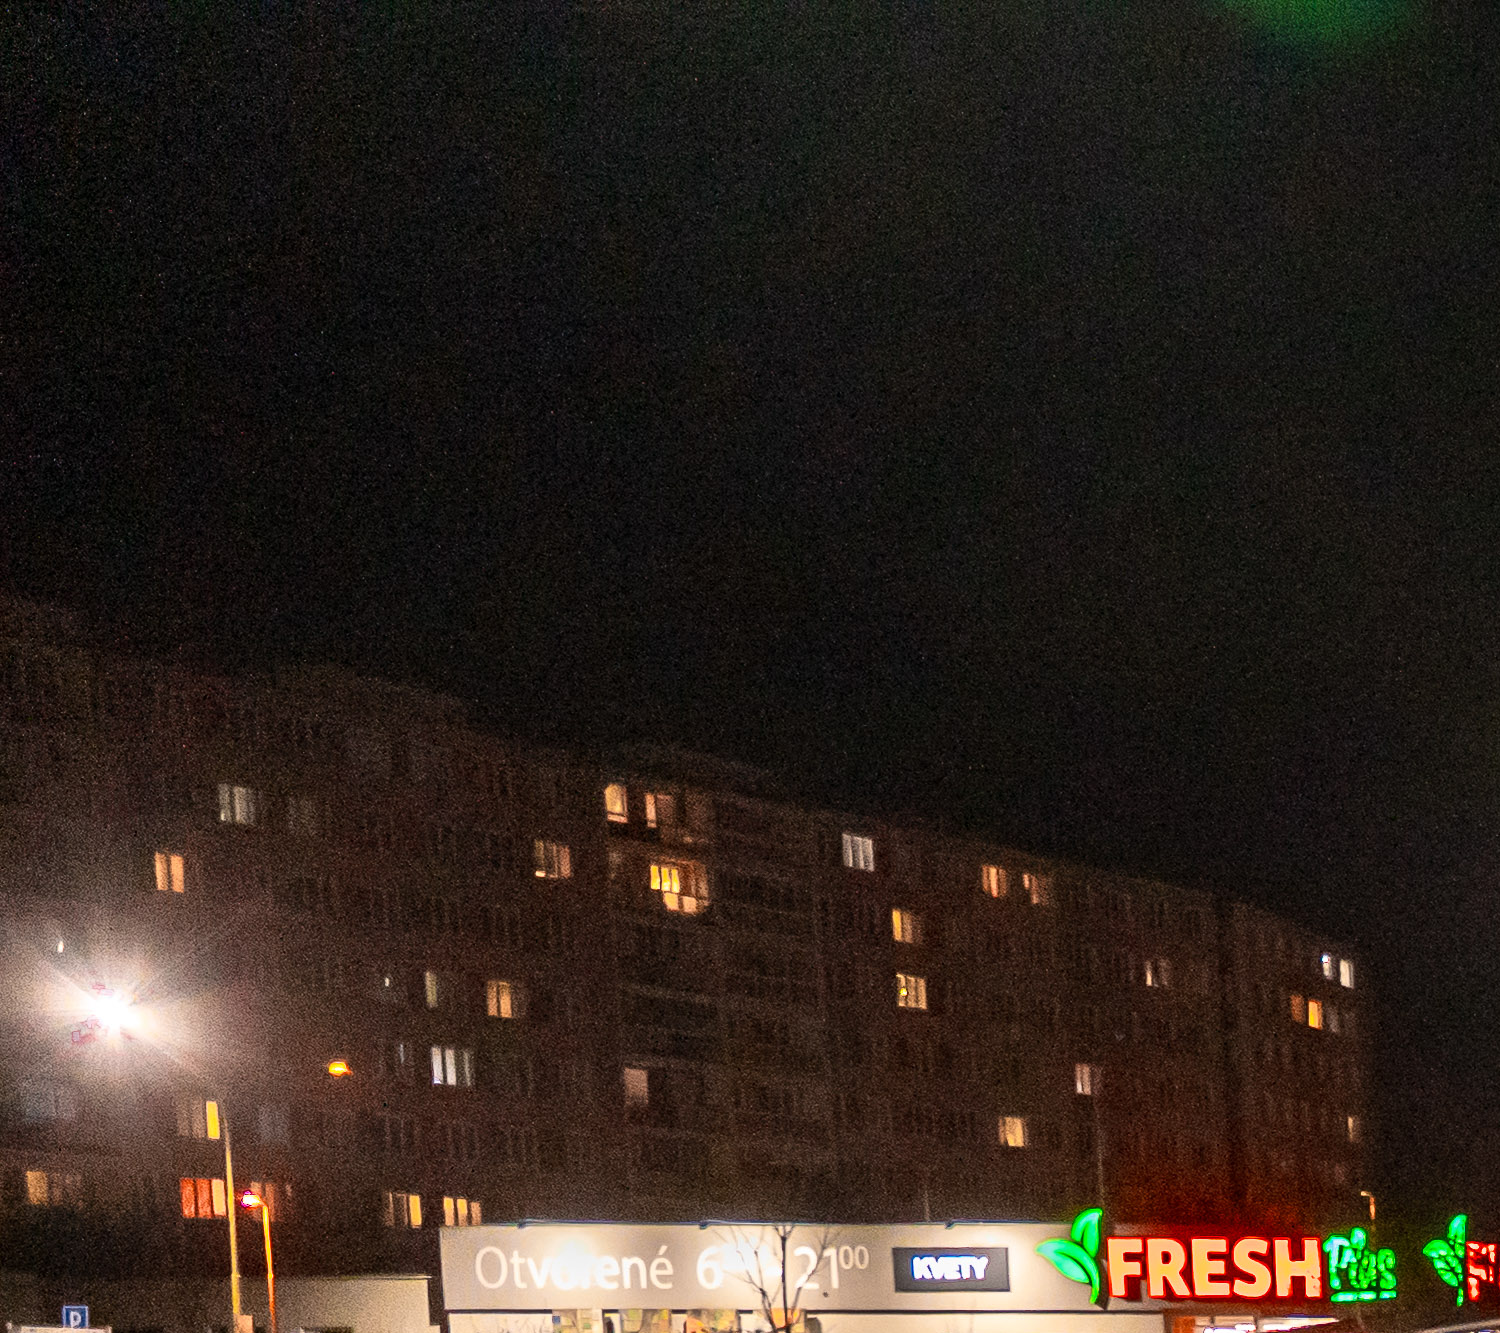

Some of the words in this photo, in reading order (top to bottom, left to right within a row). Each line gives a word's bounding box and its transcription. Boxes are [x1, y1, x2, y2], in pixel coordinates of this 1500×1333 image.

[911, 1255, 989, 1280] KVETY
[1106, 1236, 1322, 1298] FRESH
[70, 1310, 82, 1328] P
